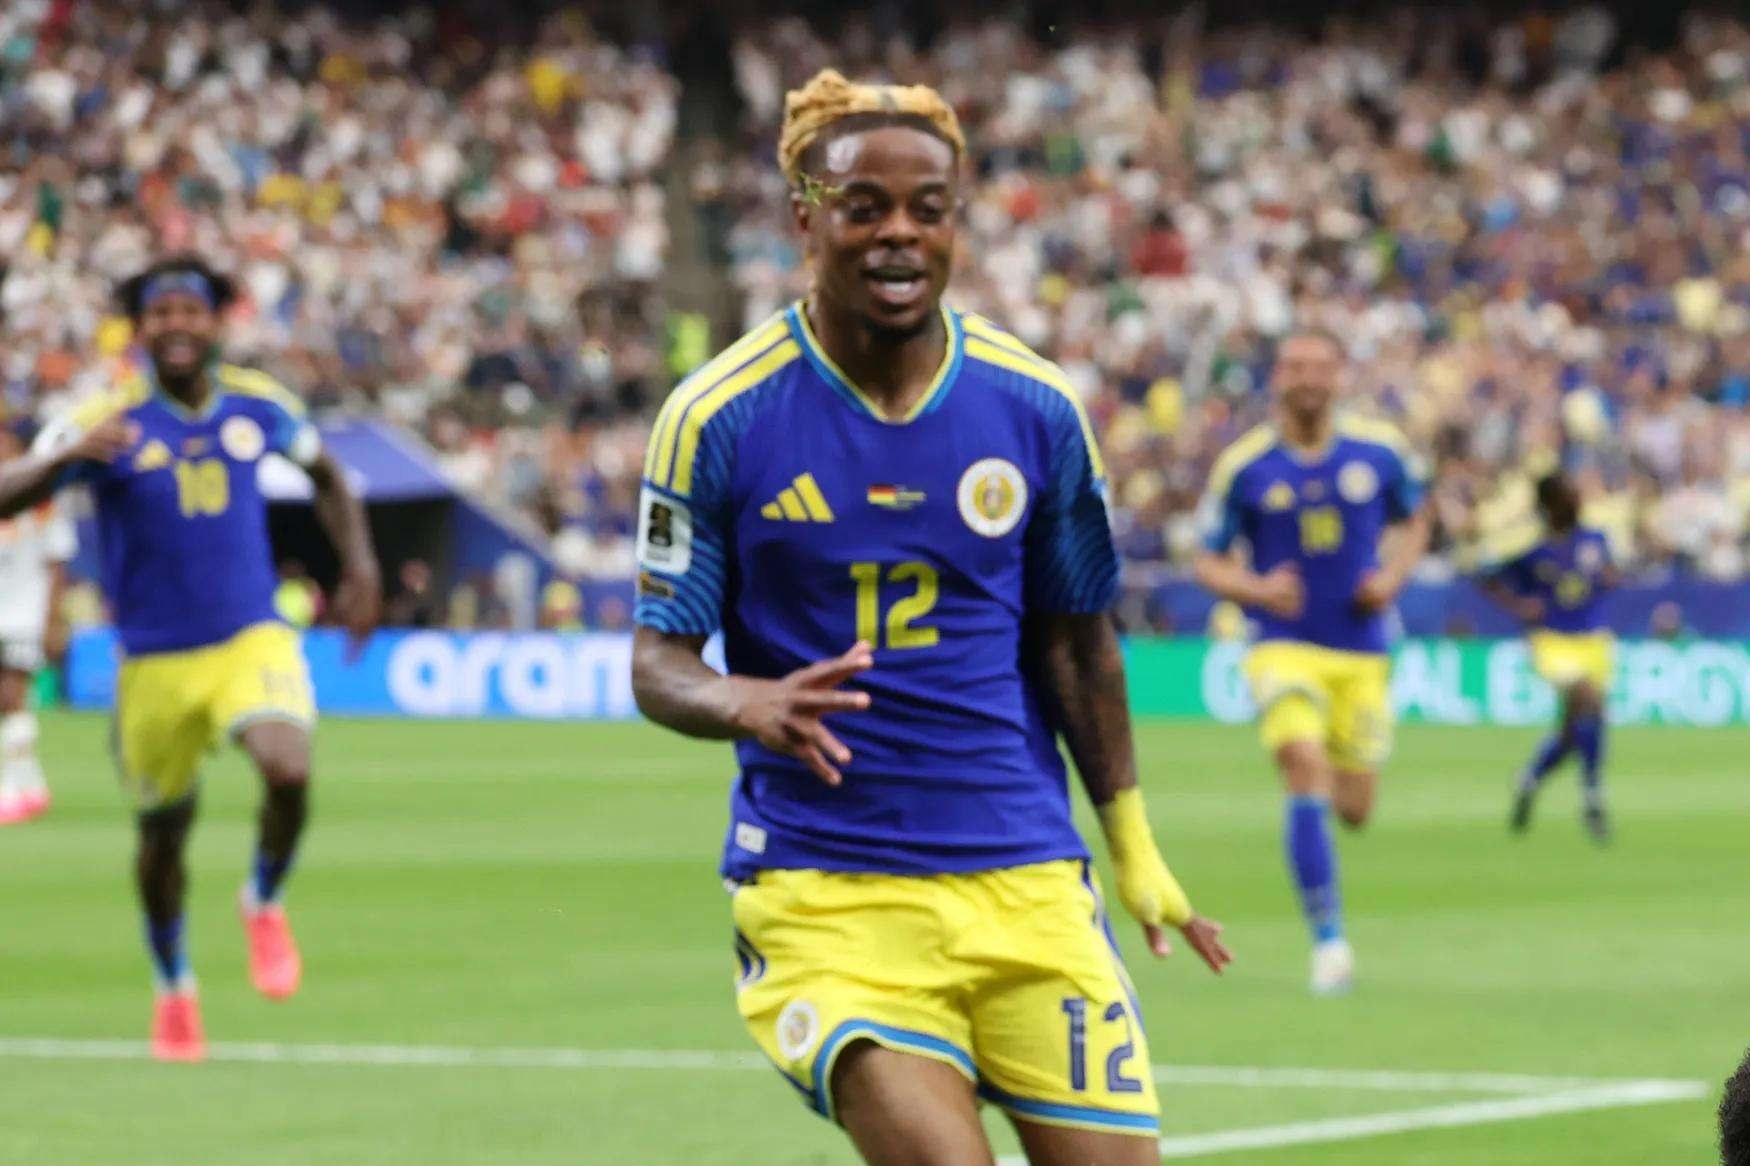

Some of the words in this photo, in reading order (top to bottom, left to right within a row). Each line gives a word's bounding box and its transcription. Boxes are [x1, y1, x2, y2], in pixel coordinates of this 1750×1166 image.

[175, 458, 228, 517] 10
[849, 561, 939, 649] 12
[387, 631, 636, 716] aram
[1202, 638, 1480, 725] GAL
[1061, 997, 1143, 1092] 12
